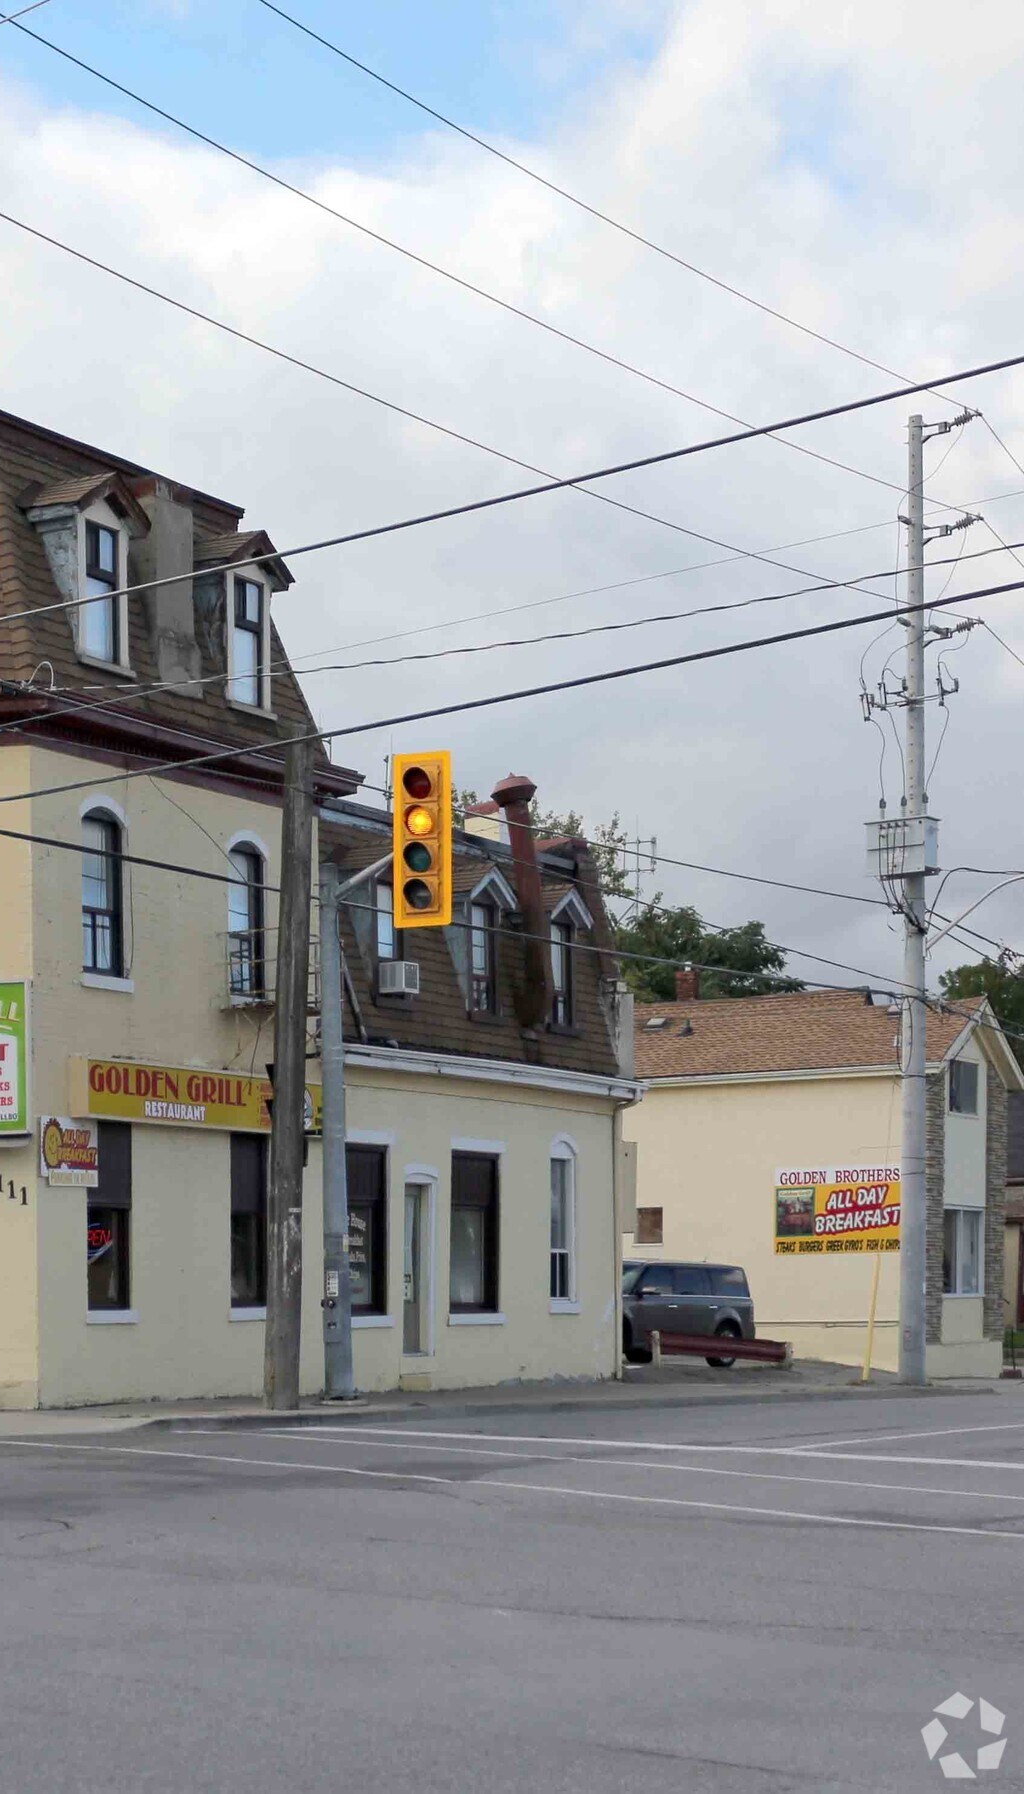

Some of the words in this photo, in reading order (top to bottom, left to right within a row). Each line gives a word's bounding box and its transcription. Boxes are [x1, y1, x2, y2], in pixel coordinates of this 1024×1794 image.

[89, 1064, 179, 1099] GOLDEN
[187, 1075, 247, 1106] GRILL
[145, 1100, 206, 1121] RESTAURANT
[62, 1129, 75, 1145] ALL
[76, 1129, 91, 1146] DAY
[56, 1147, 97, 1163] BREAKFAST
[780, 1171, 827, 1186] GOLDEN
[835, 1168, 900, 1184] BROTHERS
[827, 1191, 853, 1210] ALL
[857, 1186, 887, 1206] DAY
[815, 1206, 900, 1233] BREAKFAST
[87, 1229, 112, 1246] PEN
[776, 1241, 796, 1253] STEAKS
[799, 1241, 824, 1252] BURGERS
[826, 1240, 844, 1252] GREEK
[866, 1240, 880, 1250] FISH
